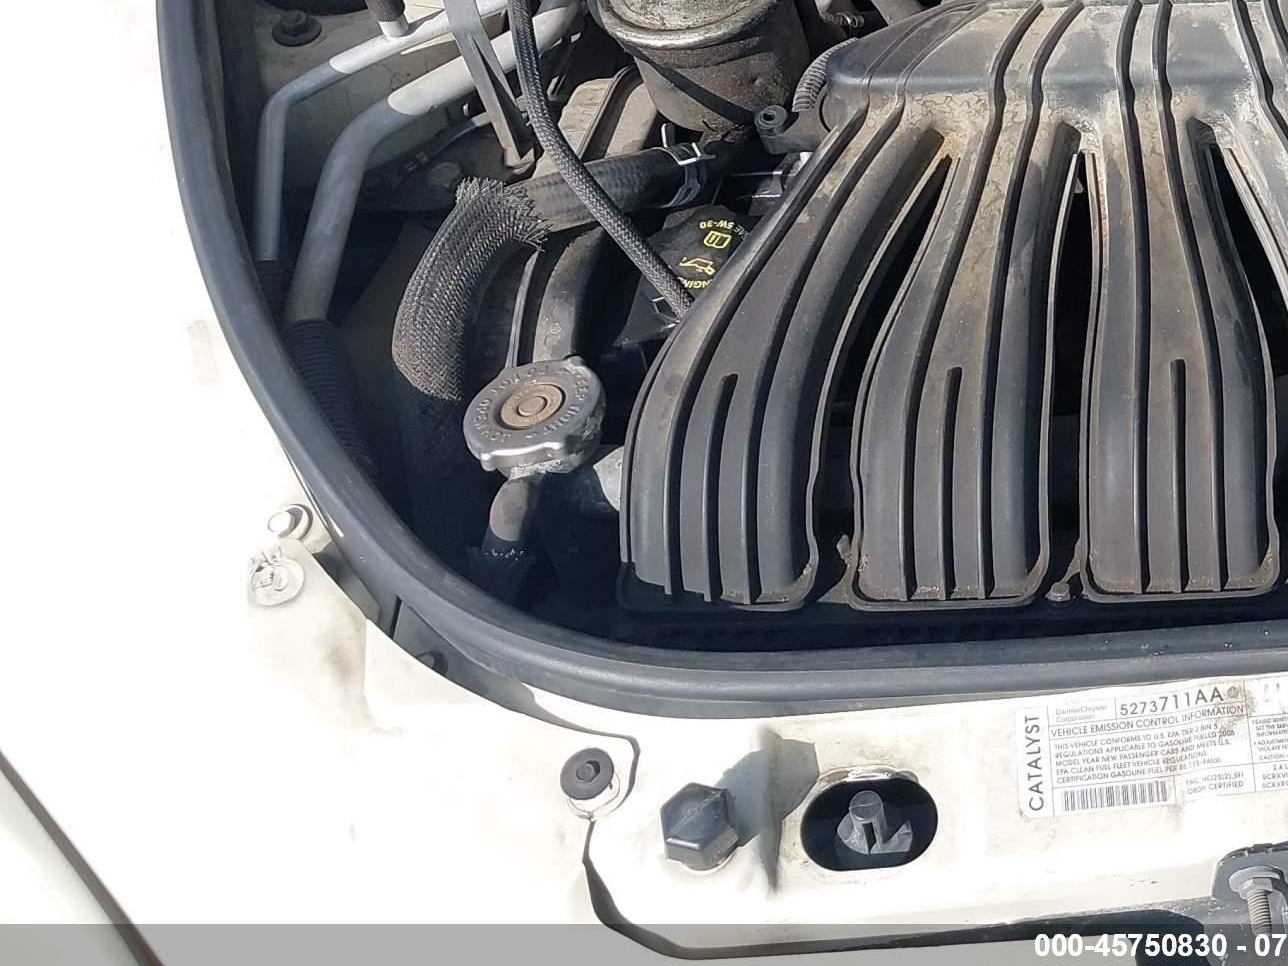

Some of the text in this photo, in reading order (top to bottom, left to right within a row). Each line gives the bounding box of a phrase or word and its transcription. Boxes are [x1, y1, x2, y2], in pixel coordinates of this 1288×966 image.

[699, 219, 735, 229] 5W-30
[678, 276, 713, 289] NGIN
[1120, 686, 1224, 716] 5273711AA
[1051, 705, 1243, 737] VEHICLE EMISSION CONTROL INFORMATION
[1071, 740, 1098, 749] VEHICLE
[1100, 735, 1141, 746] CONFORMS
[1055, 747, 1103, 759] REGULATIONS
[1106, 743, 1145, 753] APPLICABLE
[1056, 758, 1080, 767] MODEL
[1102, 754, 1116, 762] NEW
[1120, 750, 1158, 760] PASSENGER
[1024, 714, 1044, 811] CATALYST
[1070, 766, 1094, 774] CLEAN
[1114, 761, 1130, 770] FLEET
[1132, 758, 1160, 767] VEHICLE
[1056, 772, 1108, 784] CERTIFICATION
[1110, 768, 1145, 778] GASOLINE
[1208, 780, 1244, 790] CERTIFIED
